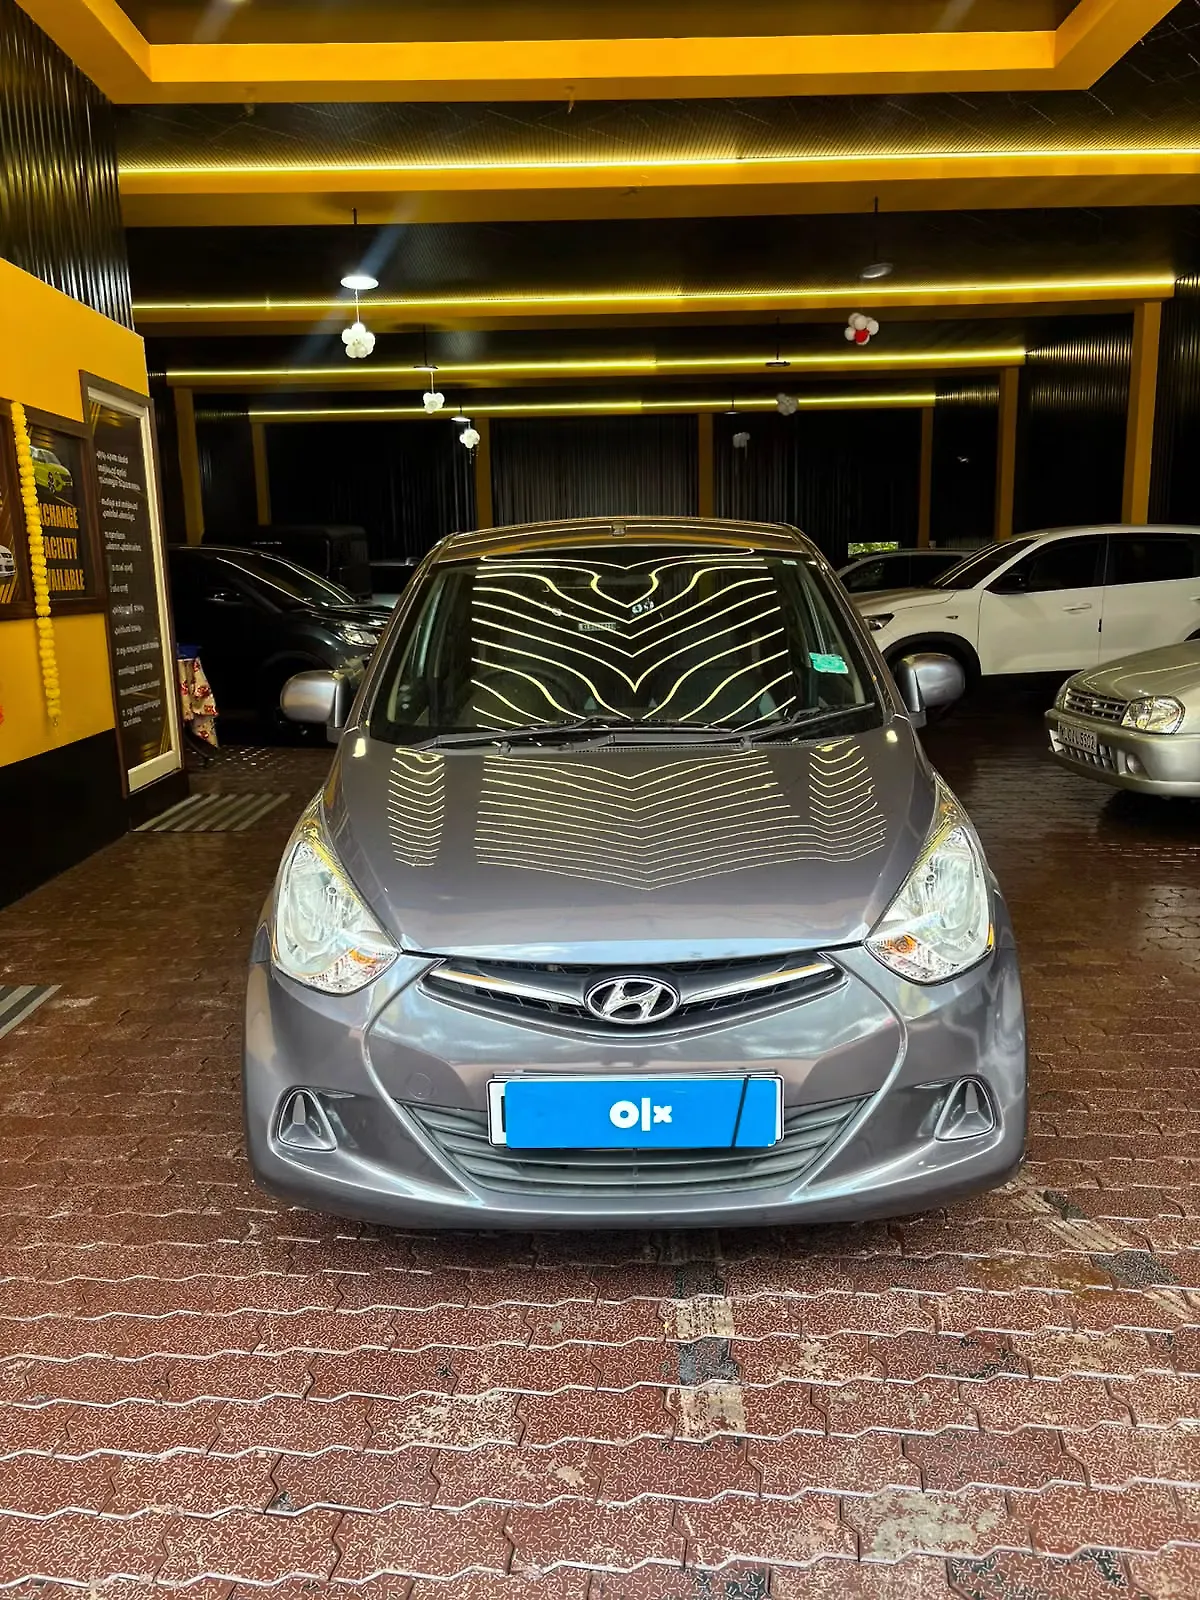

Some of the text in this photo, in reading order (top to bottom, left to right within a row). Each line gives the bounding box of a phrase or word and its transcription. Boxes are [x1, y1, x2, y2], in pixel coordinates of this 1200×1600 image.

[37, 503, 79, 529] XCHANGE
[44, 536, 78, 559] ACILITY
[47, 568, 85, 591] VAILABLE
